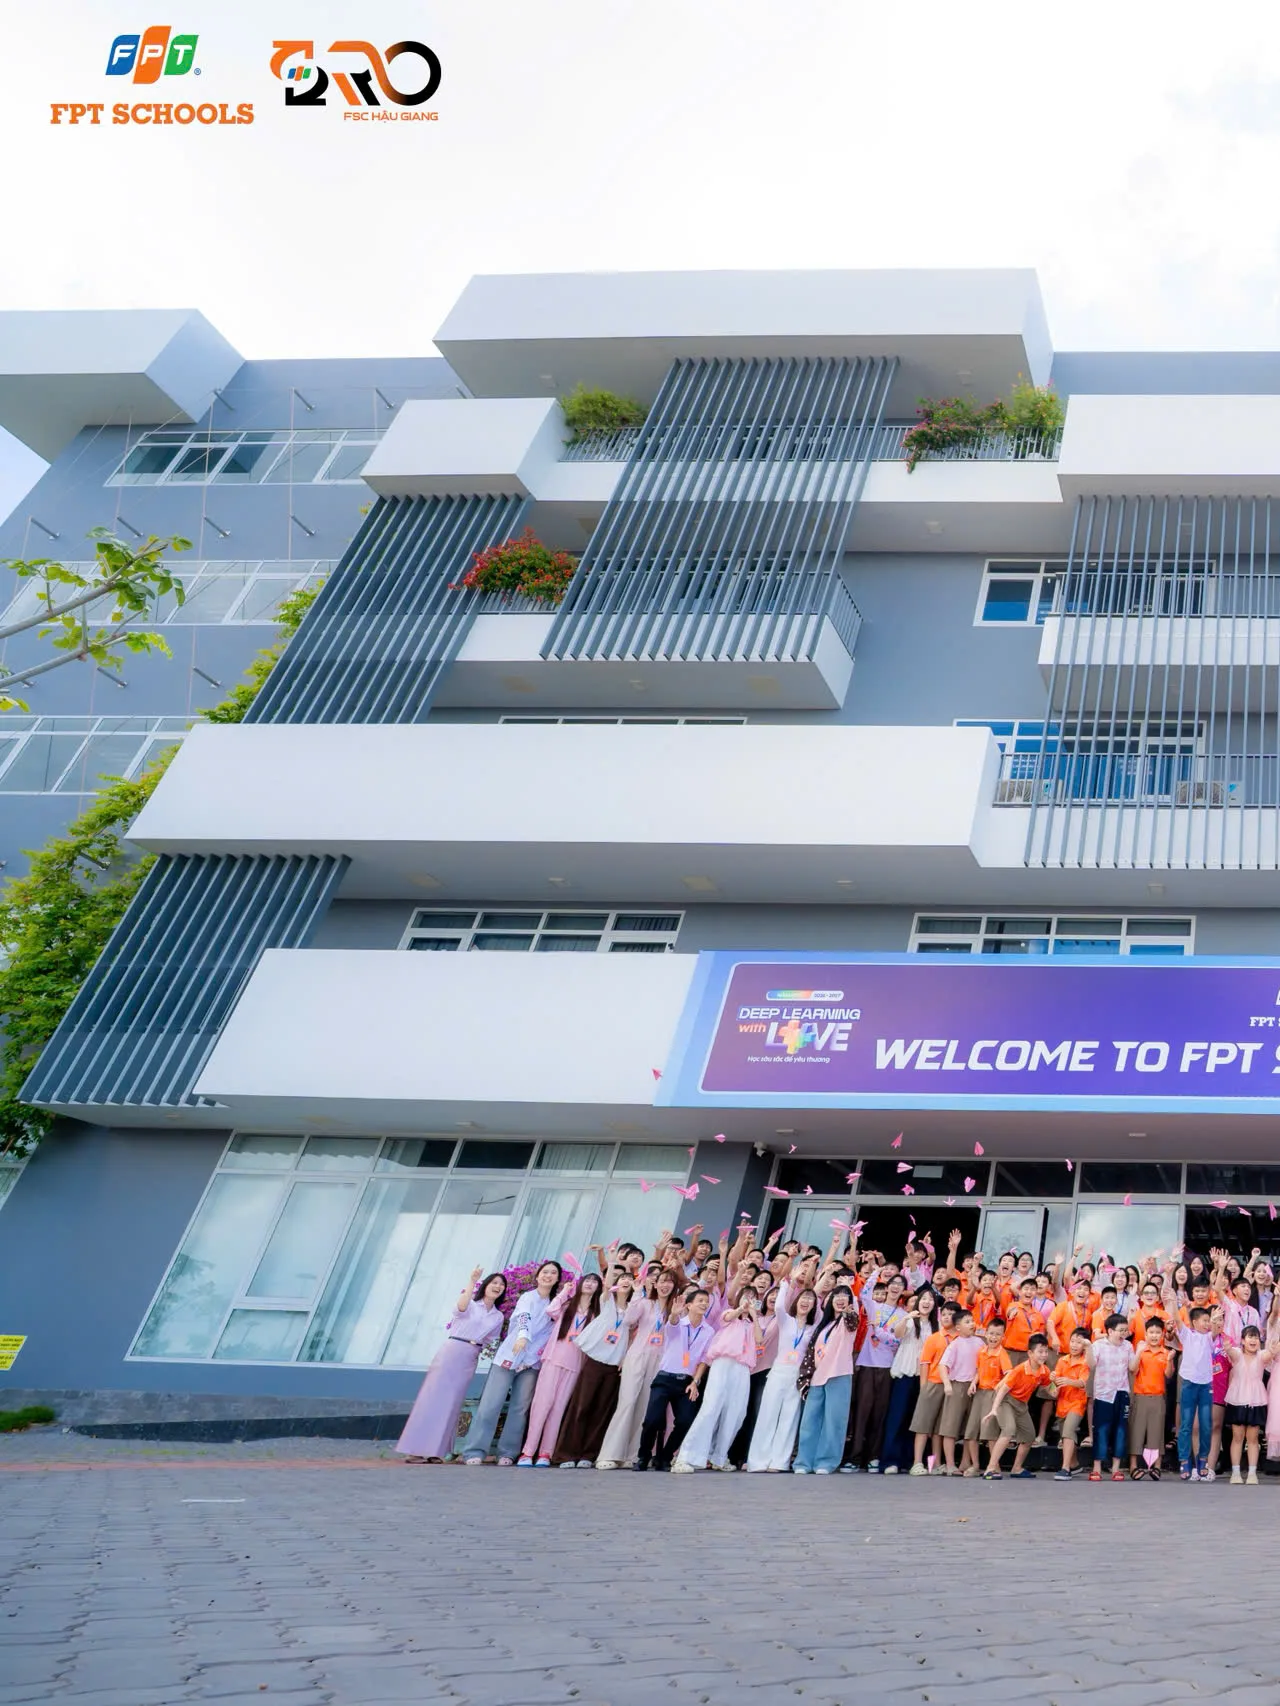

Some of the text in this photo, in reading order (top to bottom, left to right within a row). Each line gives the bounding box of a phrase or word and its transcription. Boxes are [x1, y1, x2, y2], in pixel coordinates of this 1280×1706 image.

[739, 1007, 861, 1020] DEEP LEARNING
[738, 1022, 767, 1033] with
[1249, 1016, 1276, 1027] FPT
[875, 1039, 1100, 1072] WELCOME
[1111, 1041, 1170, 1073] TO
[1179, 1042, 1264, 1074] FPT
